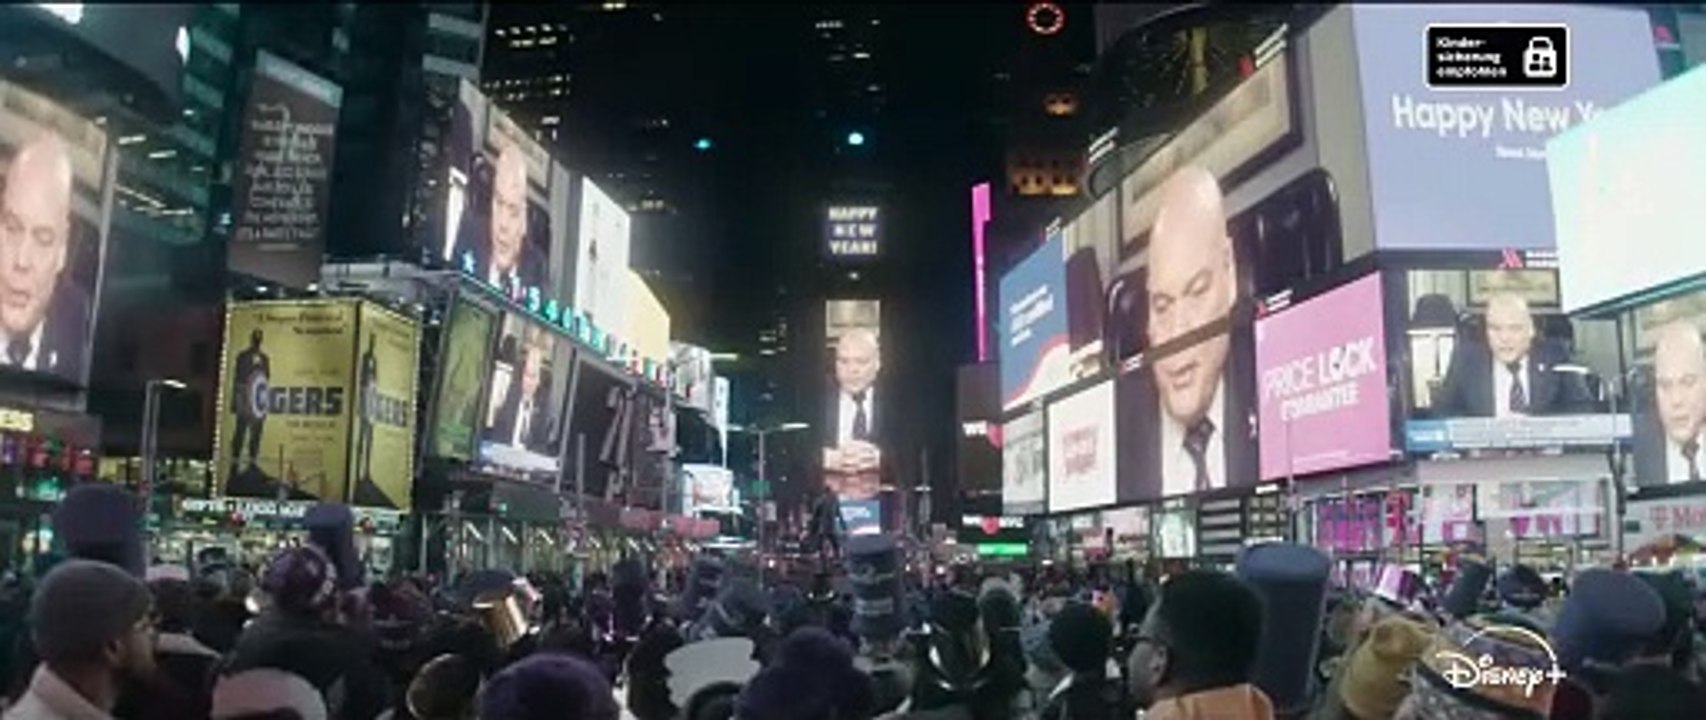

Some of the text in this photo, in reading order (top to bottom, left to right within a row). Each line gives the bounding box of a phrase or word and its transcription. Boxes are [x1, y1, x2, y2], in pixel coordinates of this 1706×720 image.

[1392, 93, 1494, 138] Happy
[1501, 98, 1570, 132] New
[829, 206, 878, 220] HAPPY
[833, 223, 877, 237] NEW
[829, 240, 877, 254] YEAR!
[1264, 336, 1377, 401] PRICE LOCK
